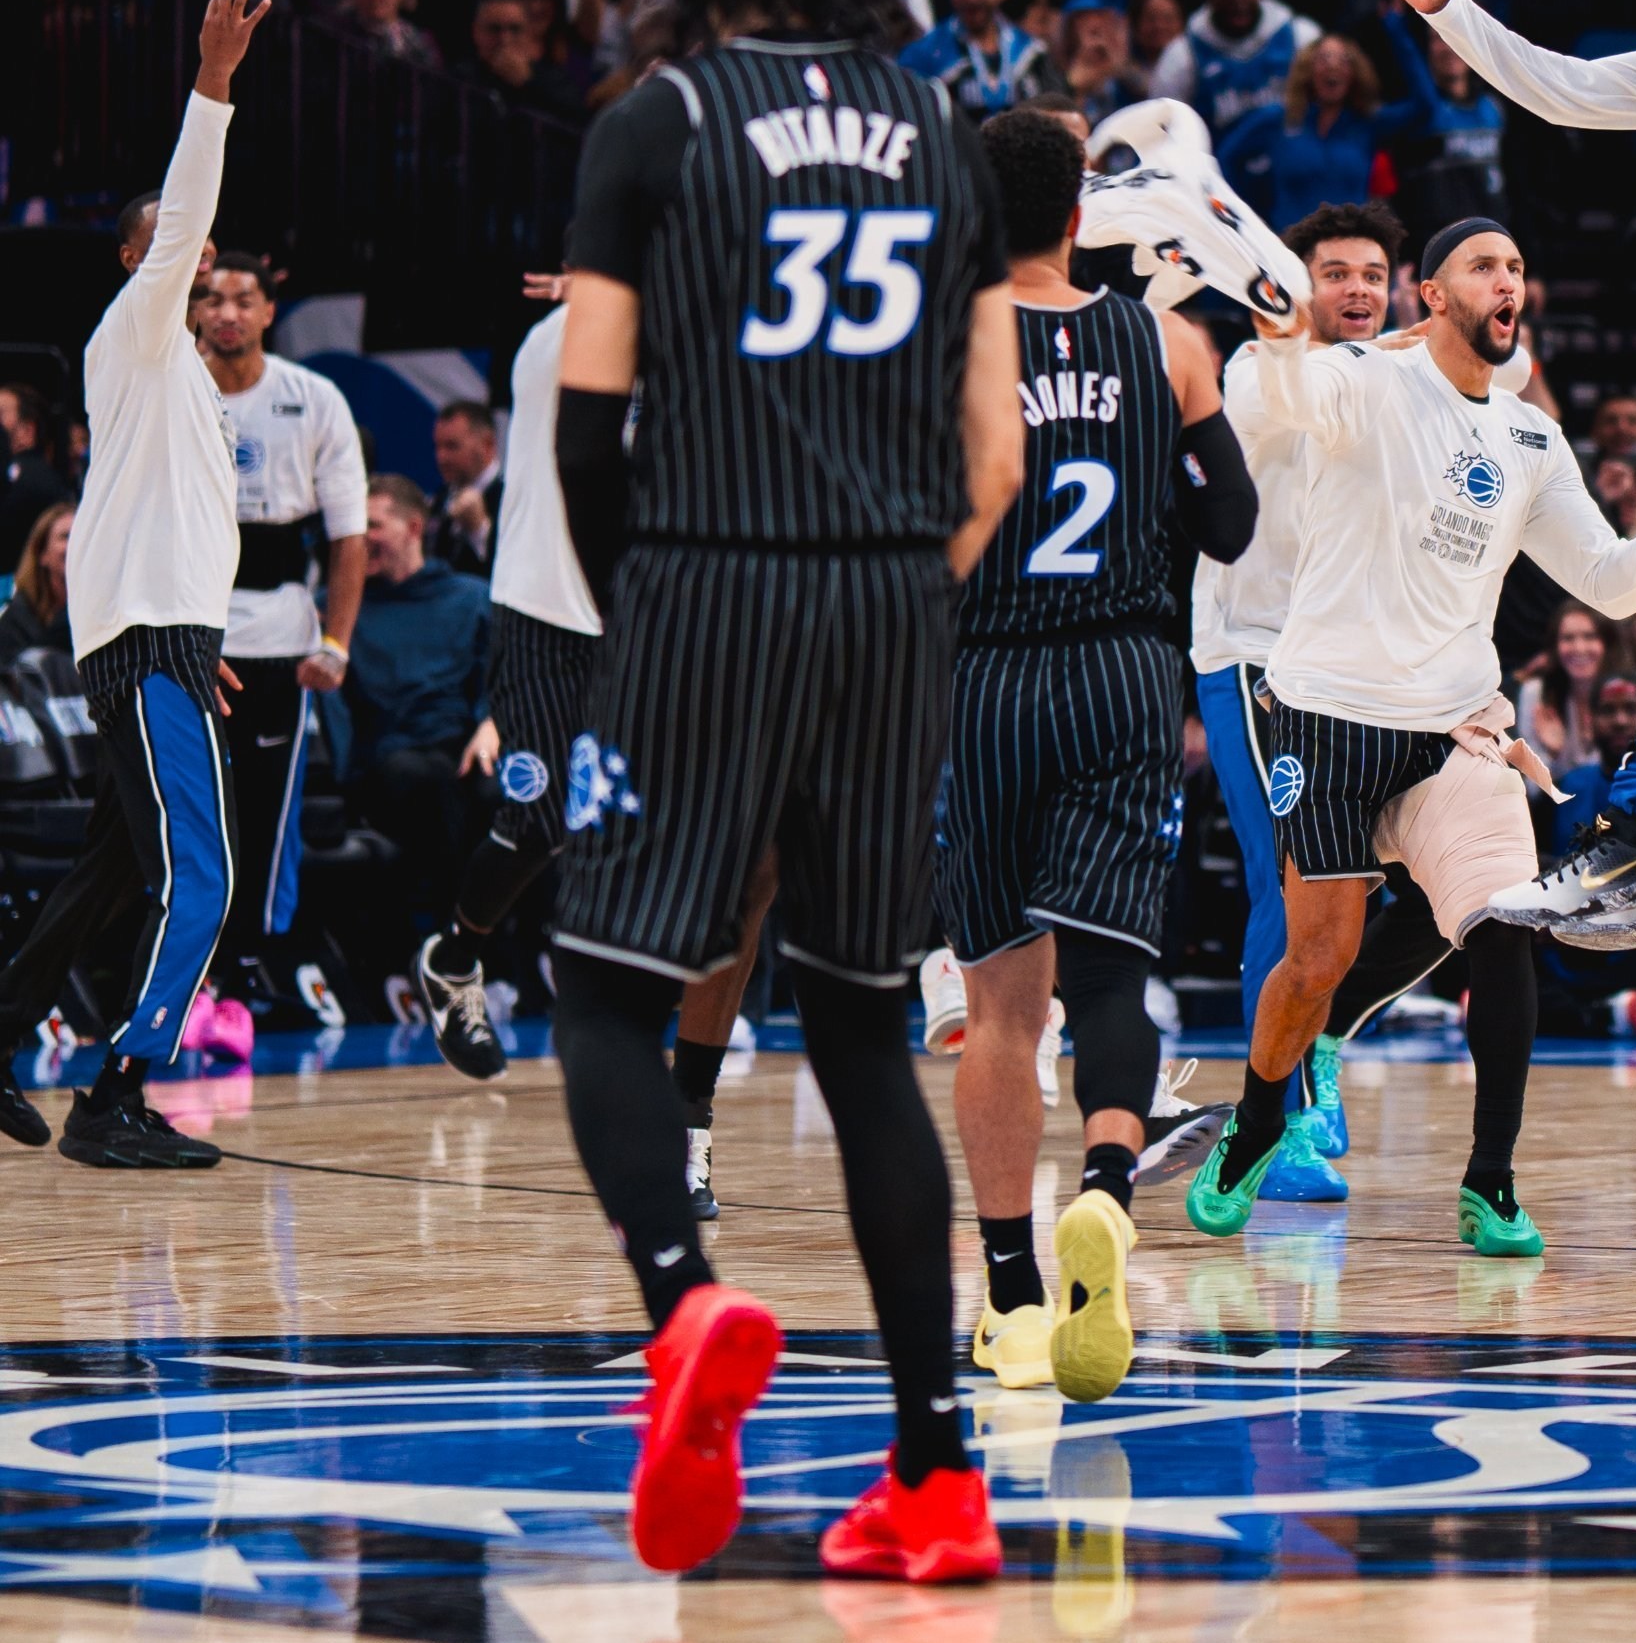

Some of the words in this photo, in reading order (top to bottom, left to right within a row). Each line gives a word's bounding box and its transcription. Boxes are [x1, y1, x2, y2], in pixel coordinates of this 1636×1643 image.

[740, 207, 936, 358] 35
[1016, 371, 1122, 427] JONES
[1023, 457, 1119, 579] 2
[1430, 505, 1469, 534] ORLANDO
